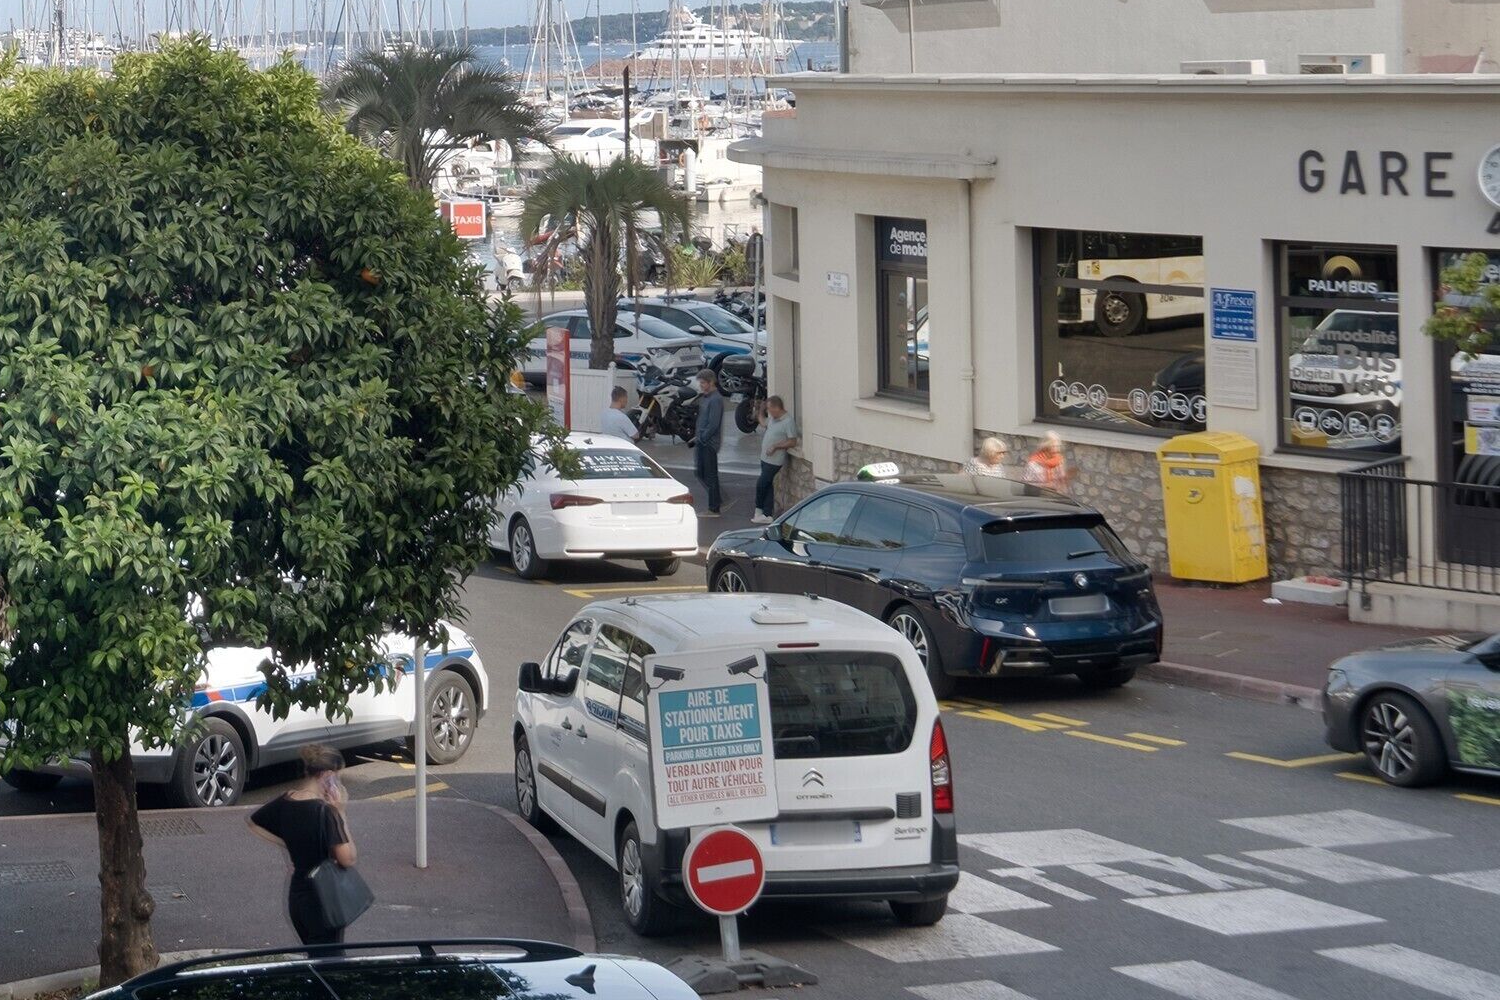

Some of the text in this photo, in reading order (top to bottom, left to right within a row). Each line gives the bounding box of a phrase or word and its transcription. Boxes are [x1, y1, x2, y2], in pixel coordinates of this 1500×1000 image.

[1298, 149, 1456, 198] GARE
[454, 215, 482, 225] TAXIS
[890, 227, 926, 243] Agence
[890, 240, 901, 254] de
[1307, 279, 1379, 293] PALM BUS
[1336, 343, 1397, 374] Bus
[1291, 366, 1334, 381] Digital
[687, 688, 730, 708] AIRE DE
[665, 703, 755, 728] STATIONNEMENT
[680, 722, 743, 744] POUR TAXIS
[665, 742, 761, 761] PARKING AREA FOR TAXI ONLY
[666, 757, 763, 779] VERBALISATION POUR
[667, 779, 689, 793] TOUT
[692, 776, 719, 790] AUTRE
[670, 786, 765, 804] ALL OTHER VEHICLES WILL BE FINED
[894, 826, 928, 835] Berlingo
